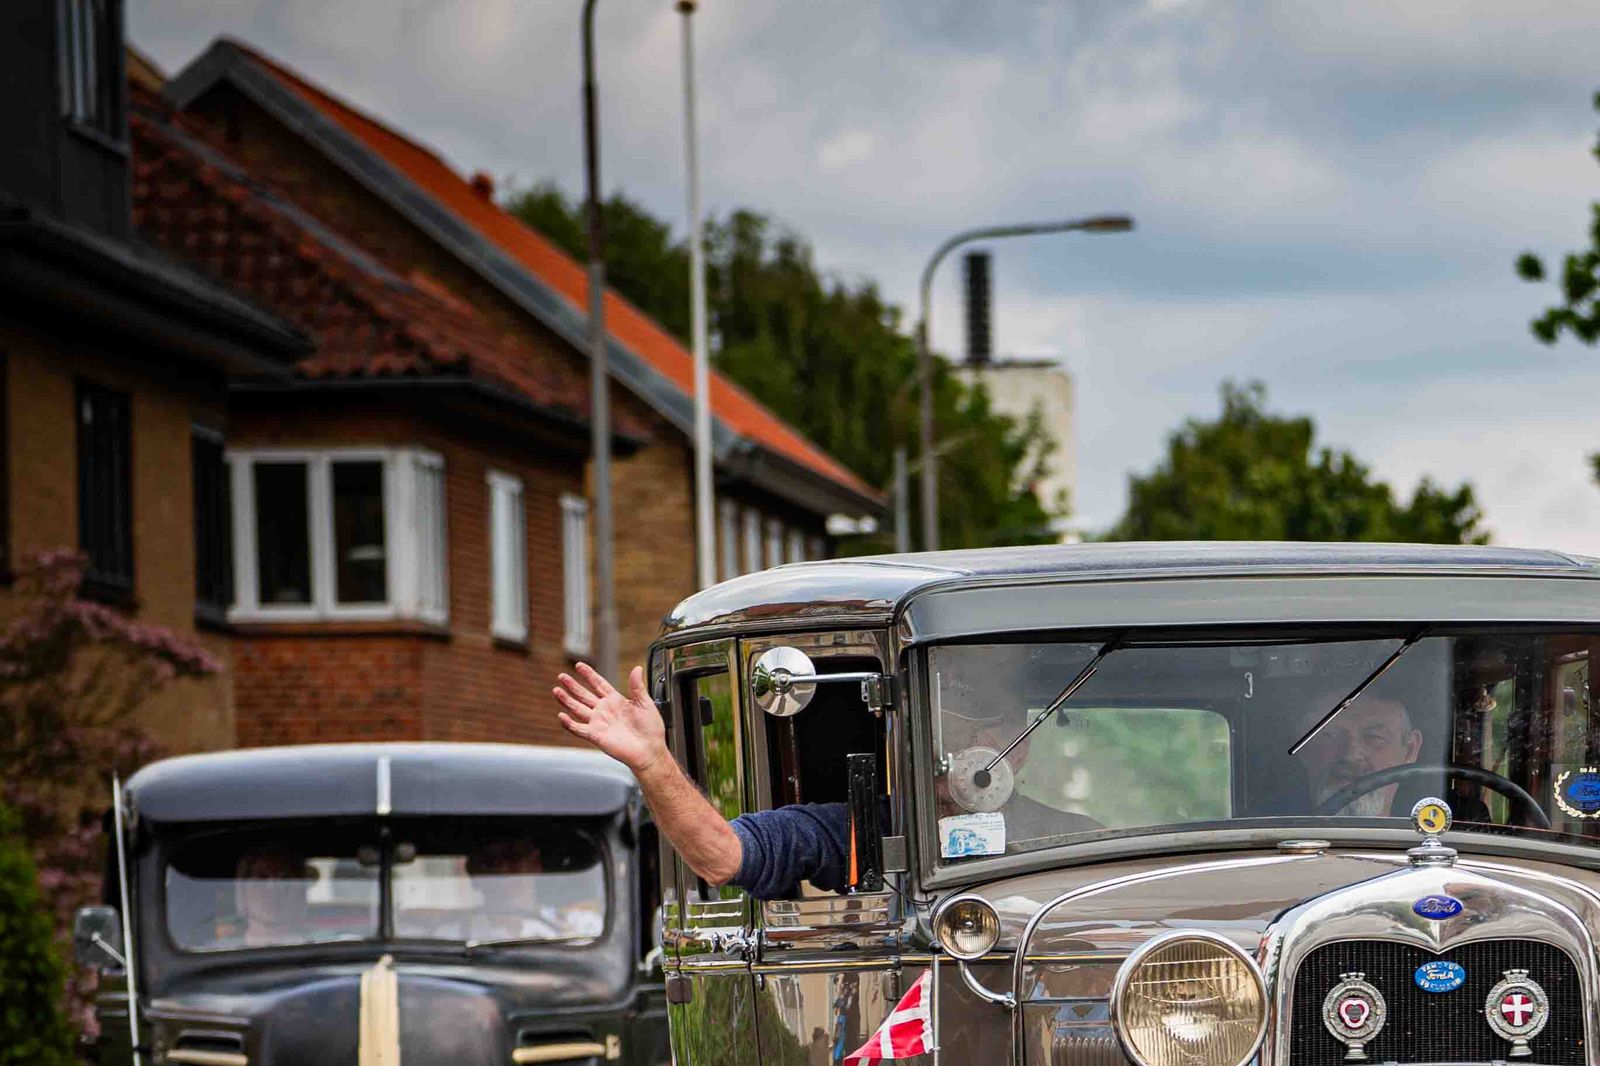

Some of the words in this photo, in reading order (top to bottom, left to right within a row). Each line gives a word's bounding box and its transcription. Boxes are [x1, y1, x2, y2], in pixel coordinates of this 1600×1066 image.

[1581, 785, 1600, 796] Ford
[1421, 898, 1457, 913] Ford
[1426, 969, 1448, 980] Ford
